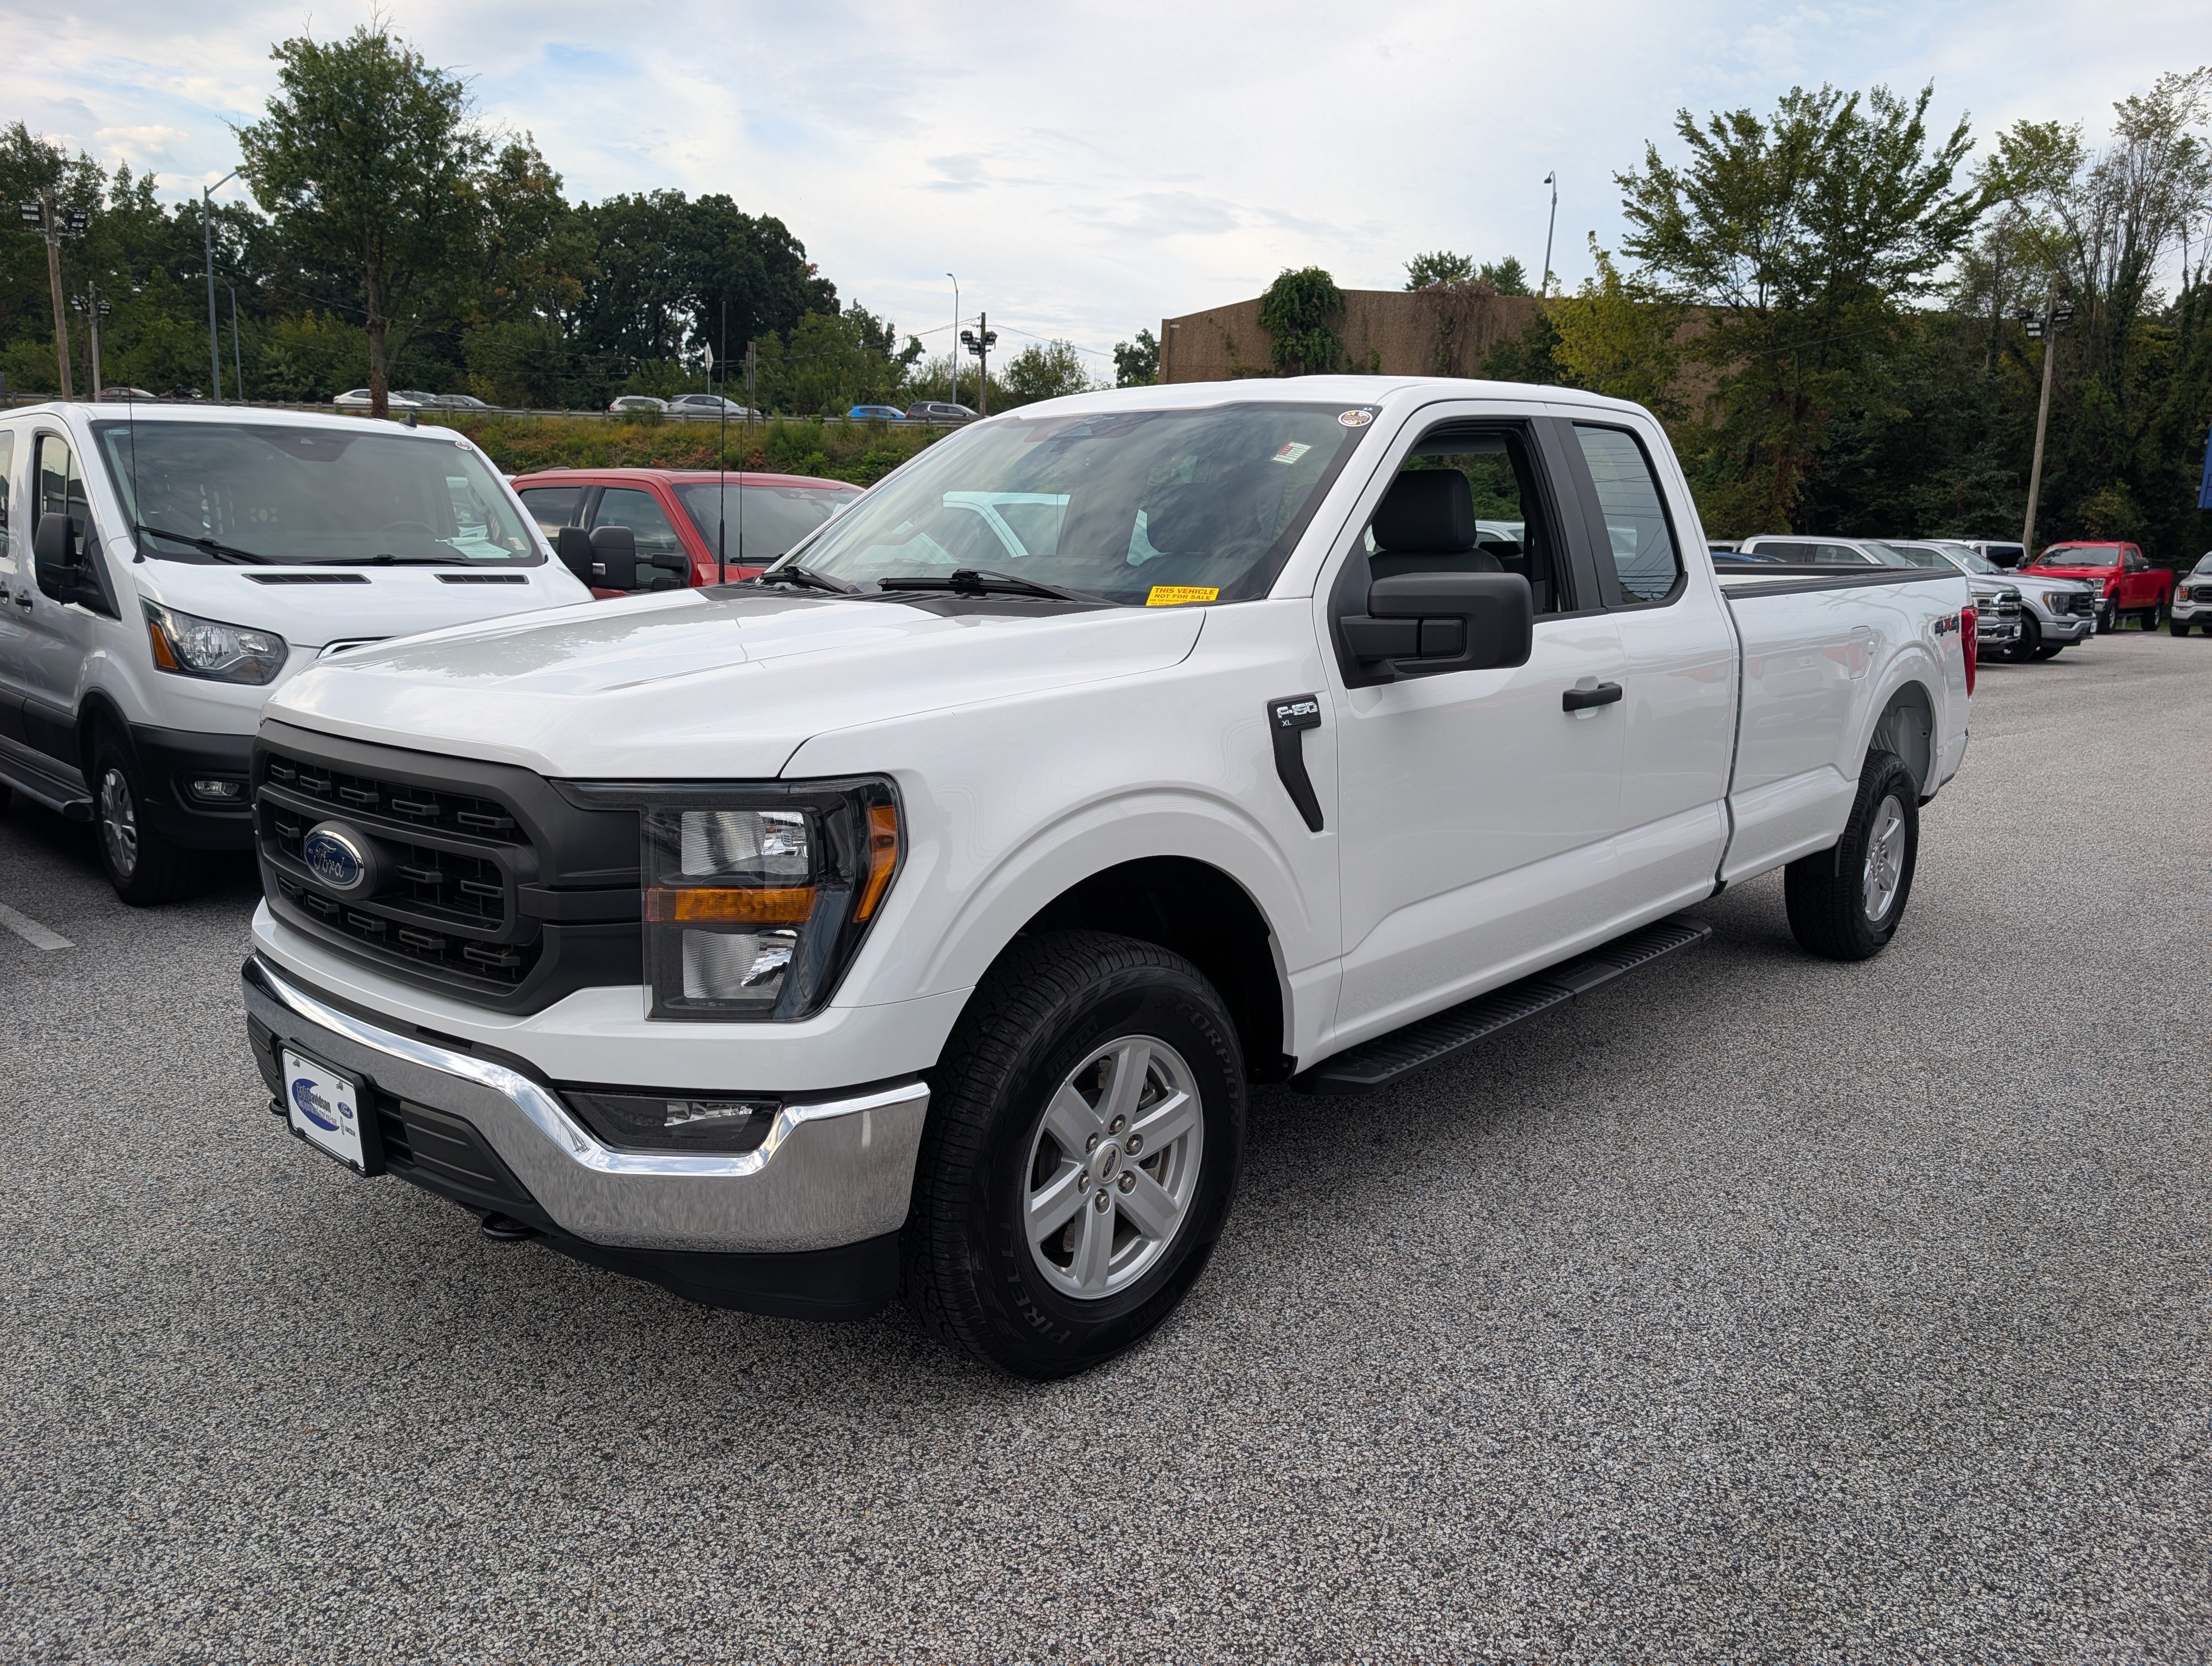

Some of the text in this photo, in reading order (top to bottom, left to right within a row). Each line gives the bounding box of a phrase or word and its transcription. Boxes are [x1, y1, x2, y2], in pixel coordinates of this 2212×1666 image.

[1277, 701, 1318, 719] F-150
[313, 842, 345, 877] Ford
[1156, 995, 1241, 1128] SCORPION
[307, 1087, 331, 1114] Davidson
[998, 1218, 1072, 1344] PIRELLI
